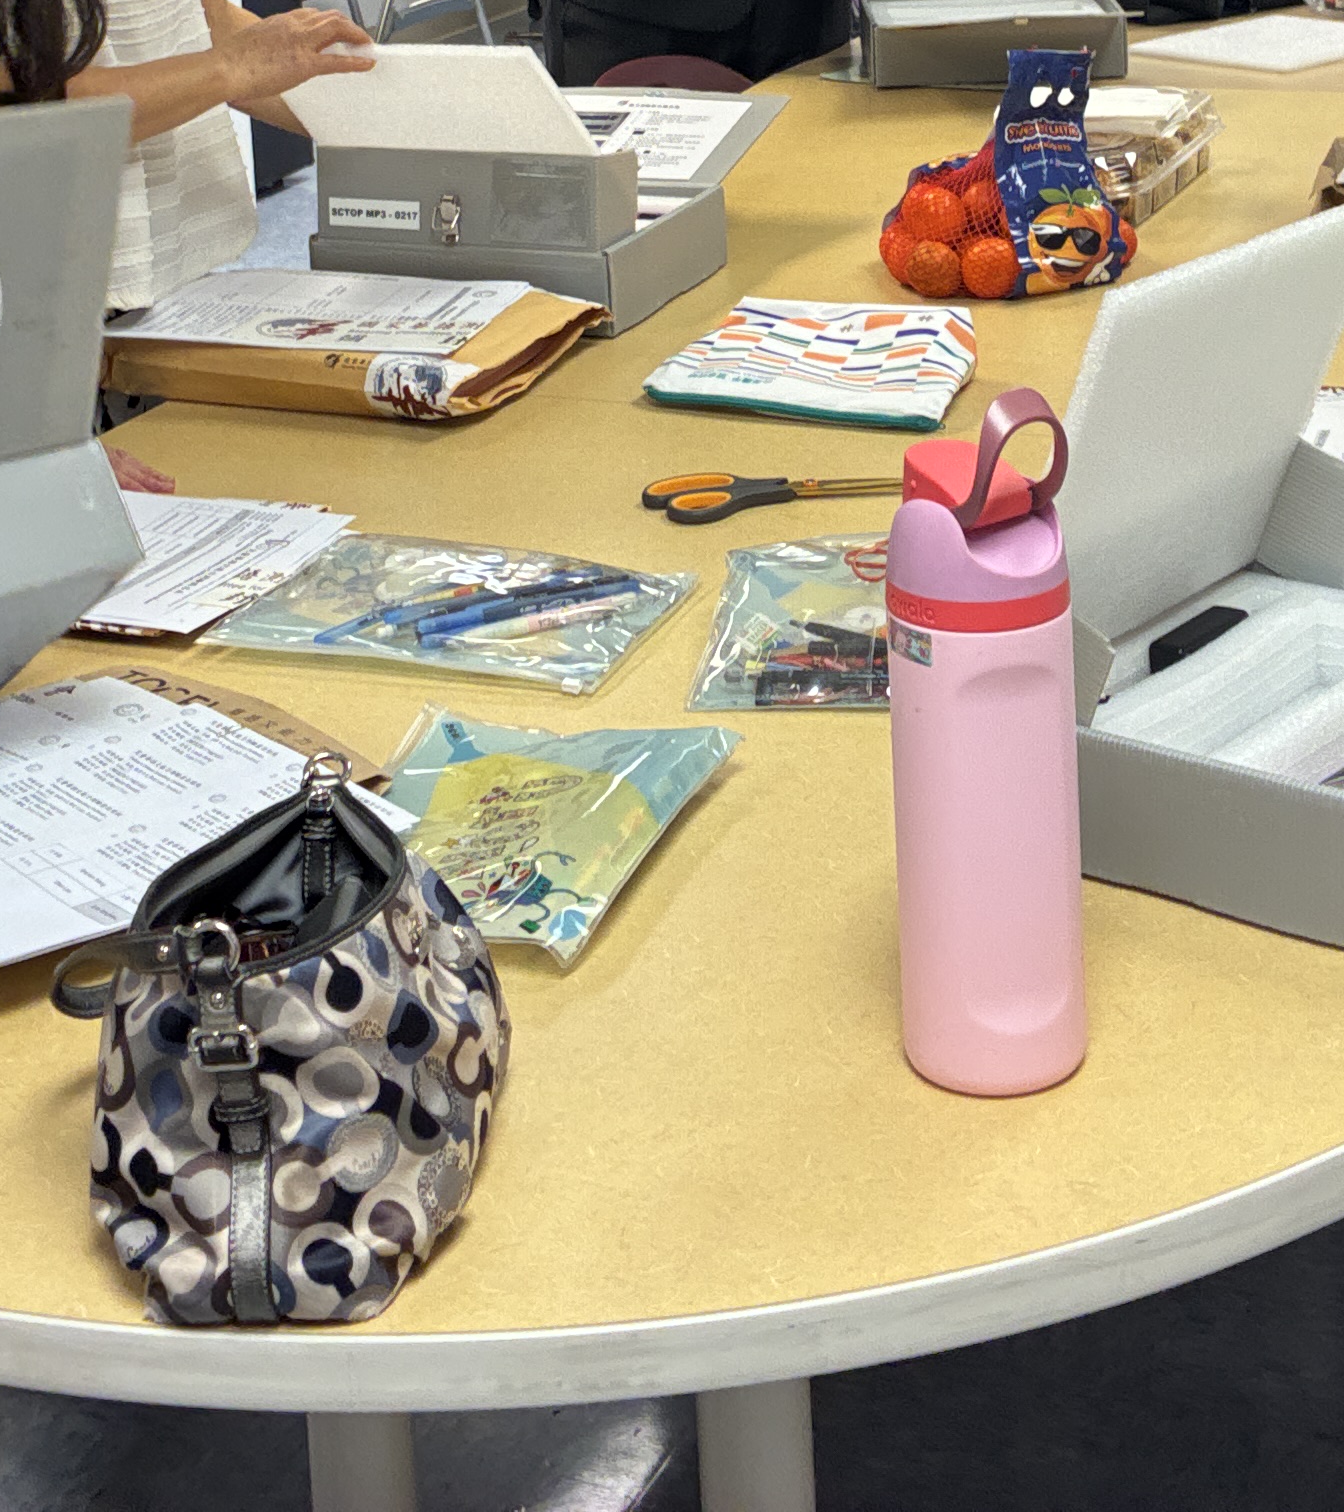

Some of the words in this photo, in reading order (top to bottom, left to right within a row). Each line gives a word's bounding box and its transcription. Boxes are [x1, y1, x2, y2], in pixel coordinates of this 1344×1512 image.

[331, 207, 363, 217] SCTOP
[366, 209, 387, 219] MP3
[394, 210, 418, 220] 0217
